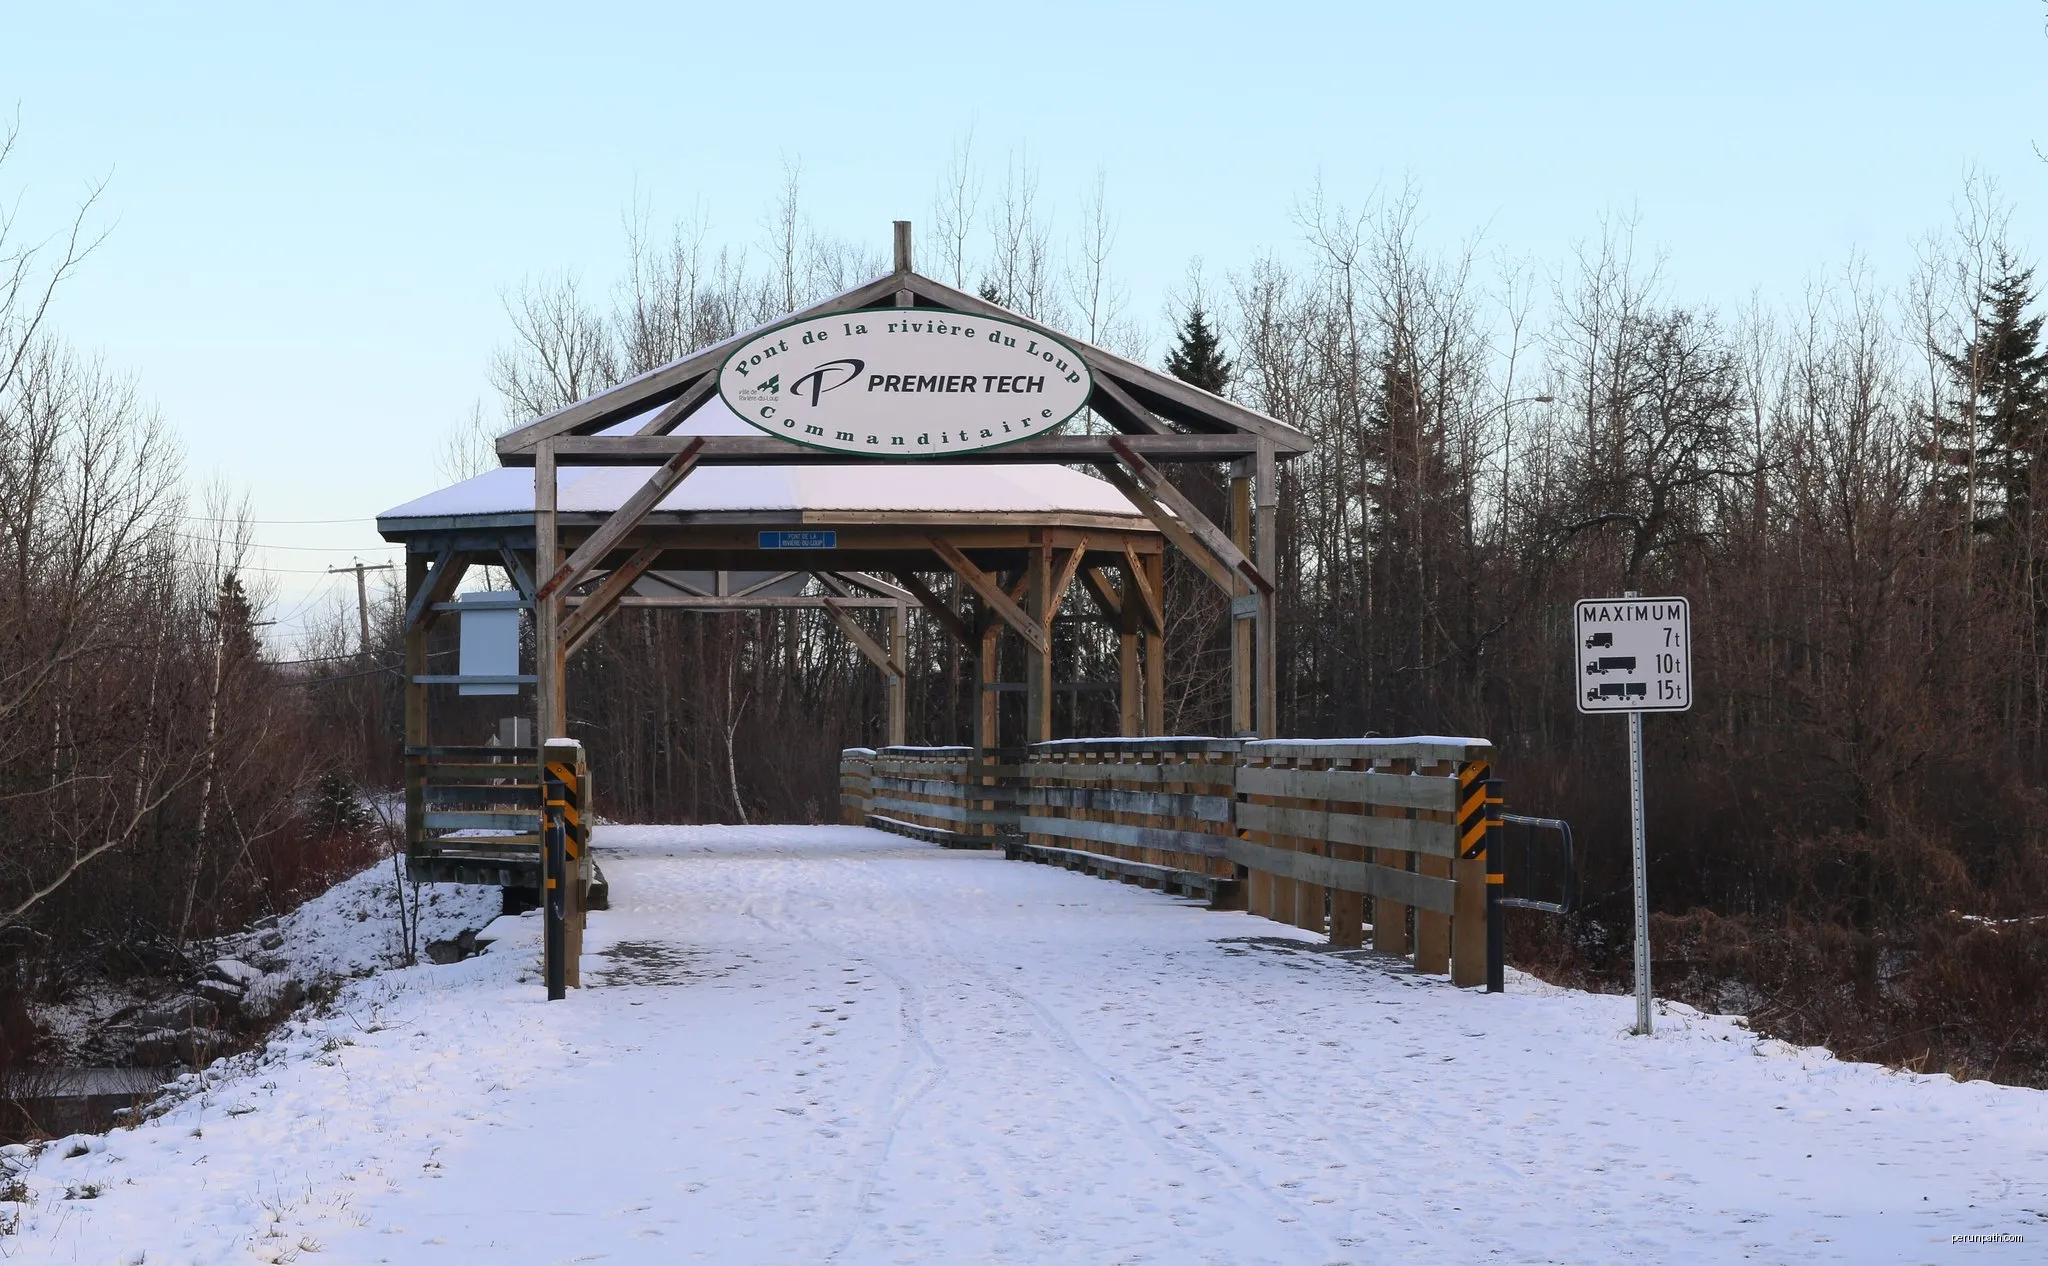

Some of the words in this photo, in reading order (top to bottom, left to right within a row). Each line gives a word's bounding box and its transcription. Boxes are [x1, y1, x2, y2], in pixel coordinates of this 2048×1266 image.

[735, 339, 789, 377] Pont
[801, 330, 828, 345] de
[843, 323, 868, 337] la
[888, 319, 976, 338] rivière
[988, 330, 1016, 348] du
[1026, 340, 1081, 384] Loup
[867, 374, 978, 393] PREMIER
[982, 375, 1046, 393] TECH
[760, 405, 1053, 446] Commanditaire
[1583, 604, 1681, 622] MAXIMUM
[1655, 653, 1680, 674] 10t
[1657, 680, 1682, 700] 15t
